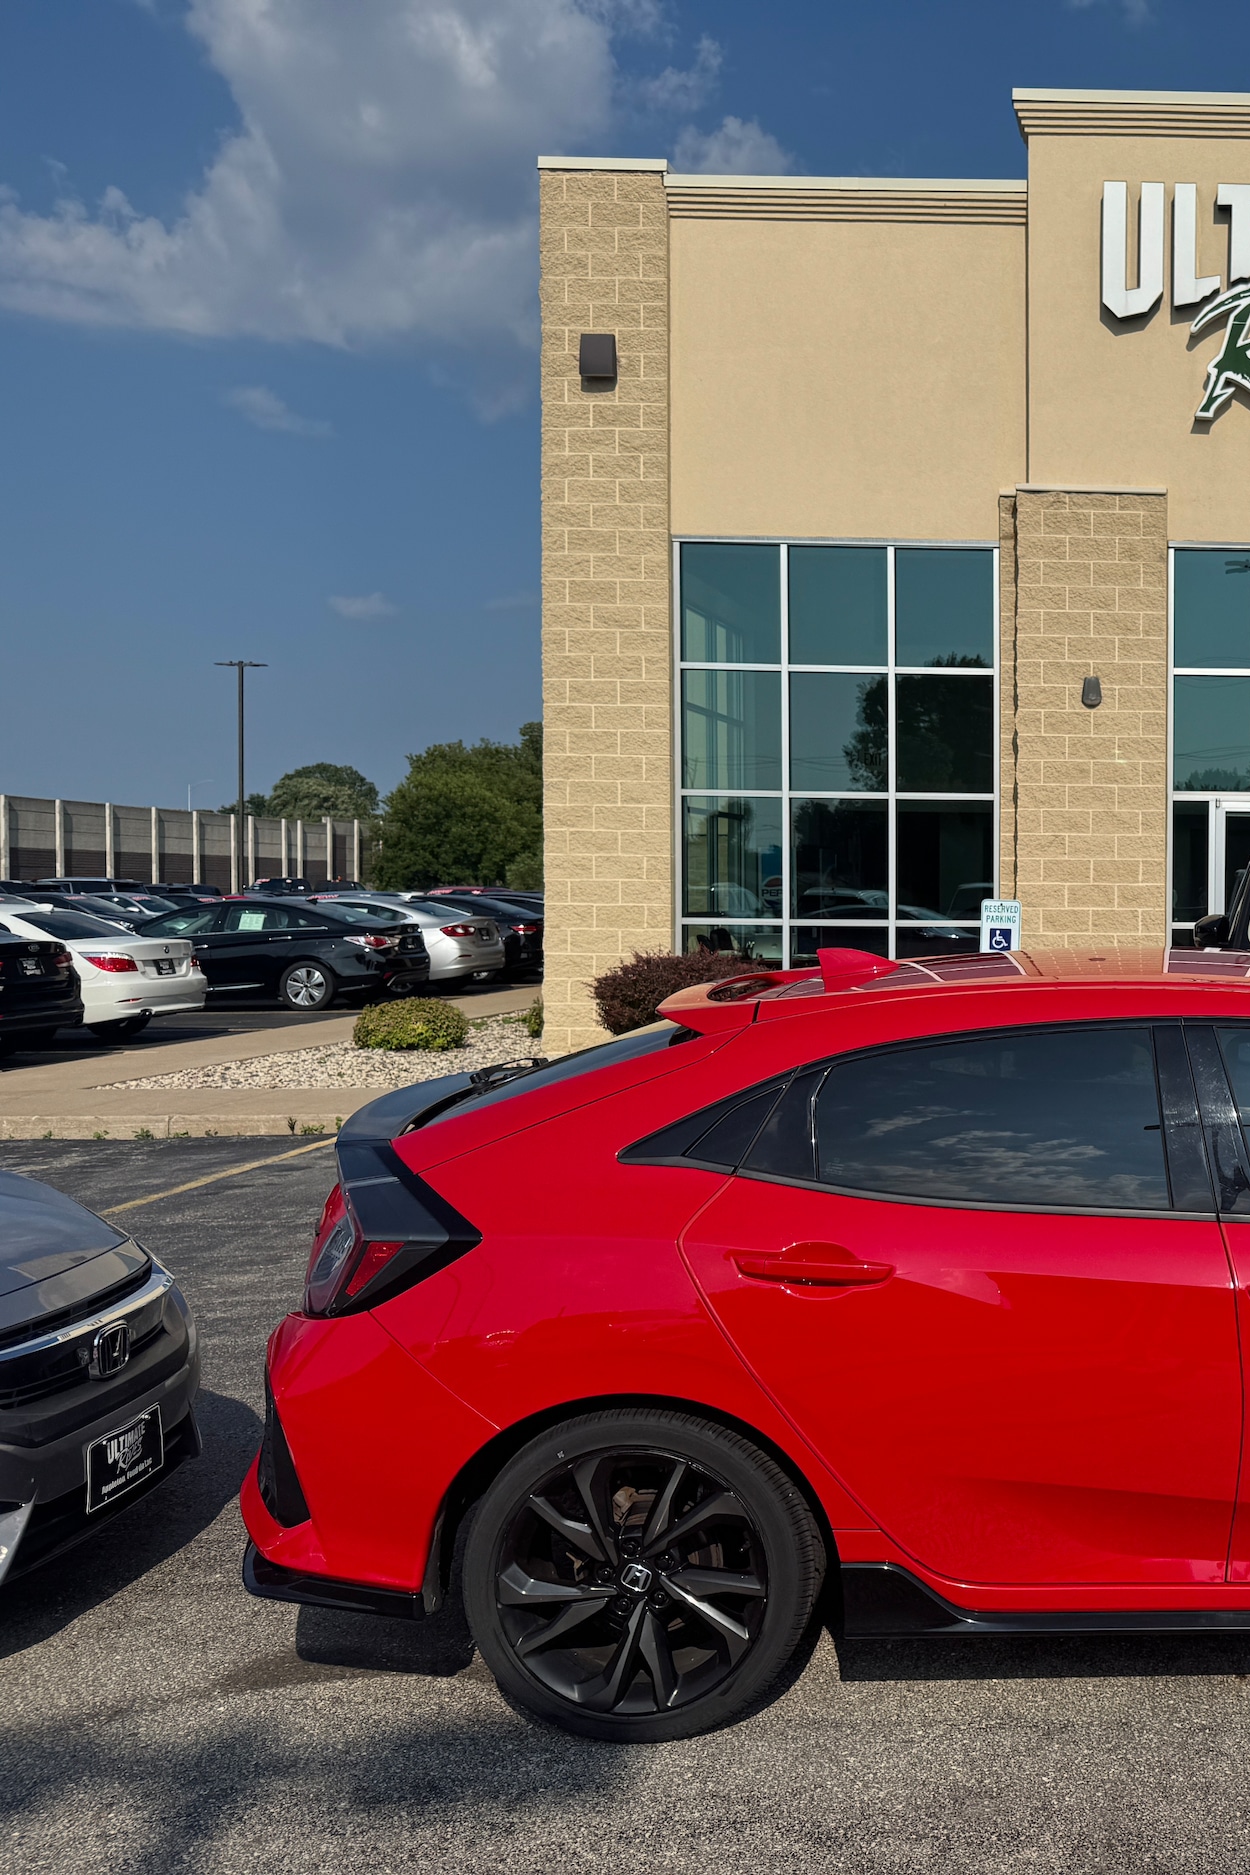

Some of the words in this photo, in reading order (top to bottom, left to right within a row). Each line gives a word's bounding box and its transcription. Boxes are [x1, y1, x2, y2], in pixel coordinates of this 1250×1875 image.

[863, 752, 882, 766] EXIT
[984, 905, 1019, 914] RESERVED
[986, 915, 1017, 924] PARKING
[106, 1421, 146, 1465] ULTIMATE
